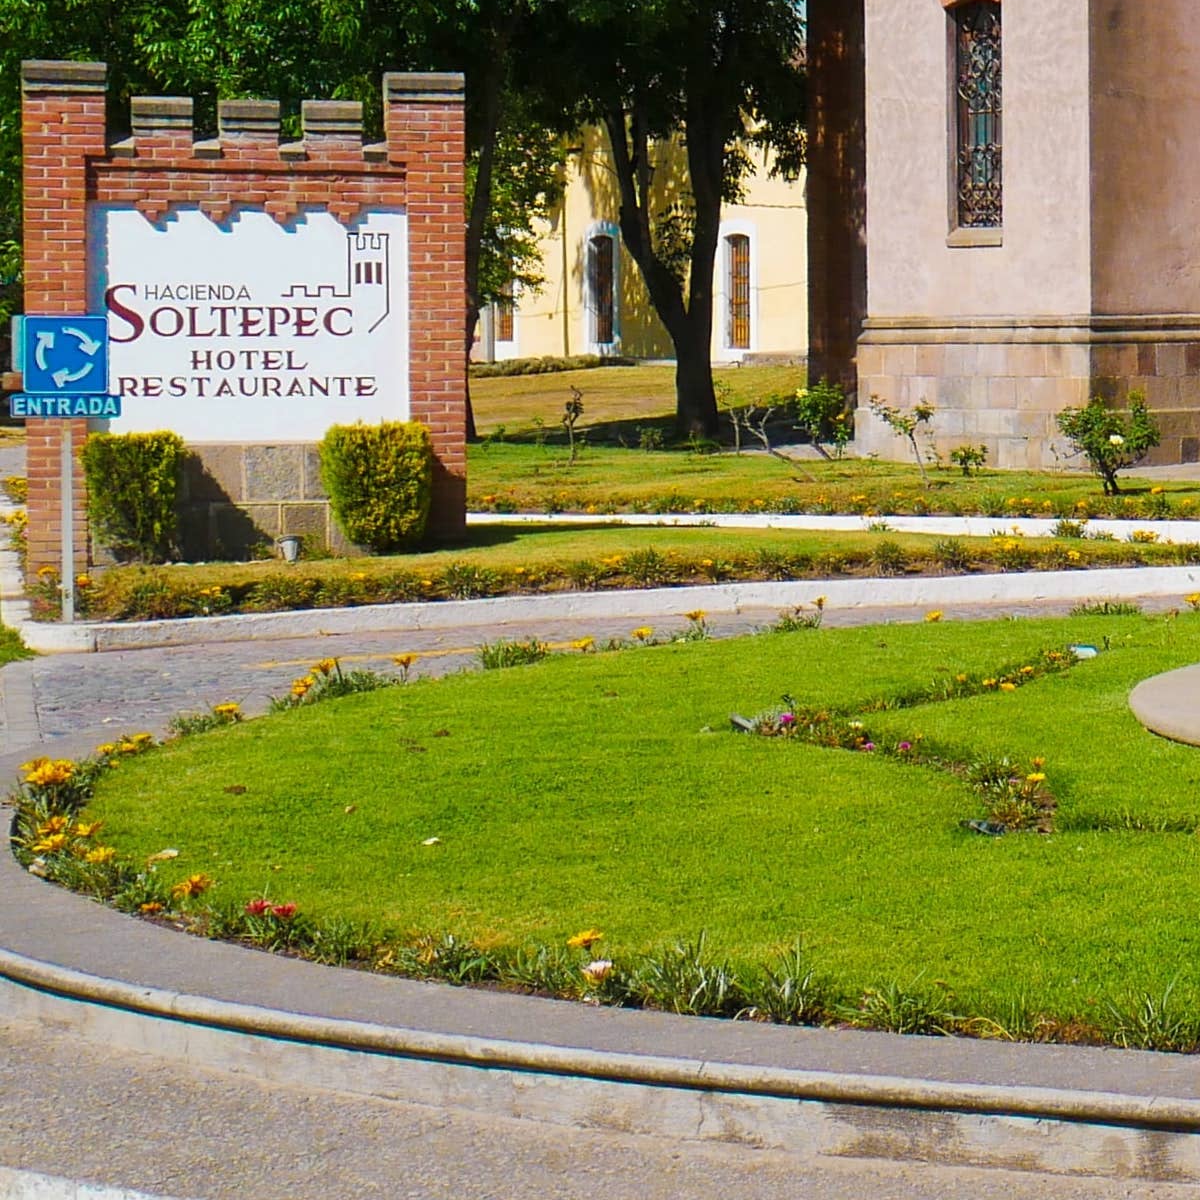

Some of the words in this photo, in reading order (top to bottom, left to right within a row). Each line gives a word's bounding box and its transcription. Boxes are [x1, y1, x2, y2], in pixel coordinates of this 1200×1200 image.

[144, 284, 252, 301] HACIENDA
[104, 284, 353, 343] SOLTEPEC
[190, 350, 308, 371] HOTEL
[117, 376, 378, 397] RESTAURANTE
[13, 397, 118, 415] ENTRADA
